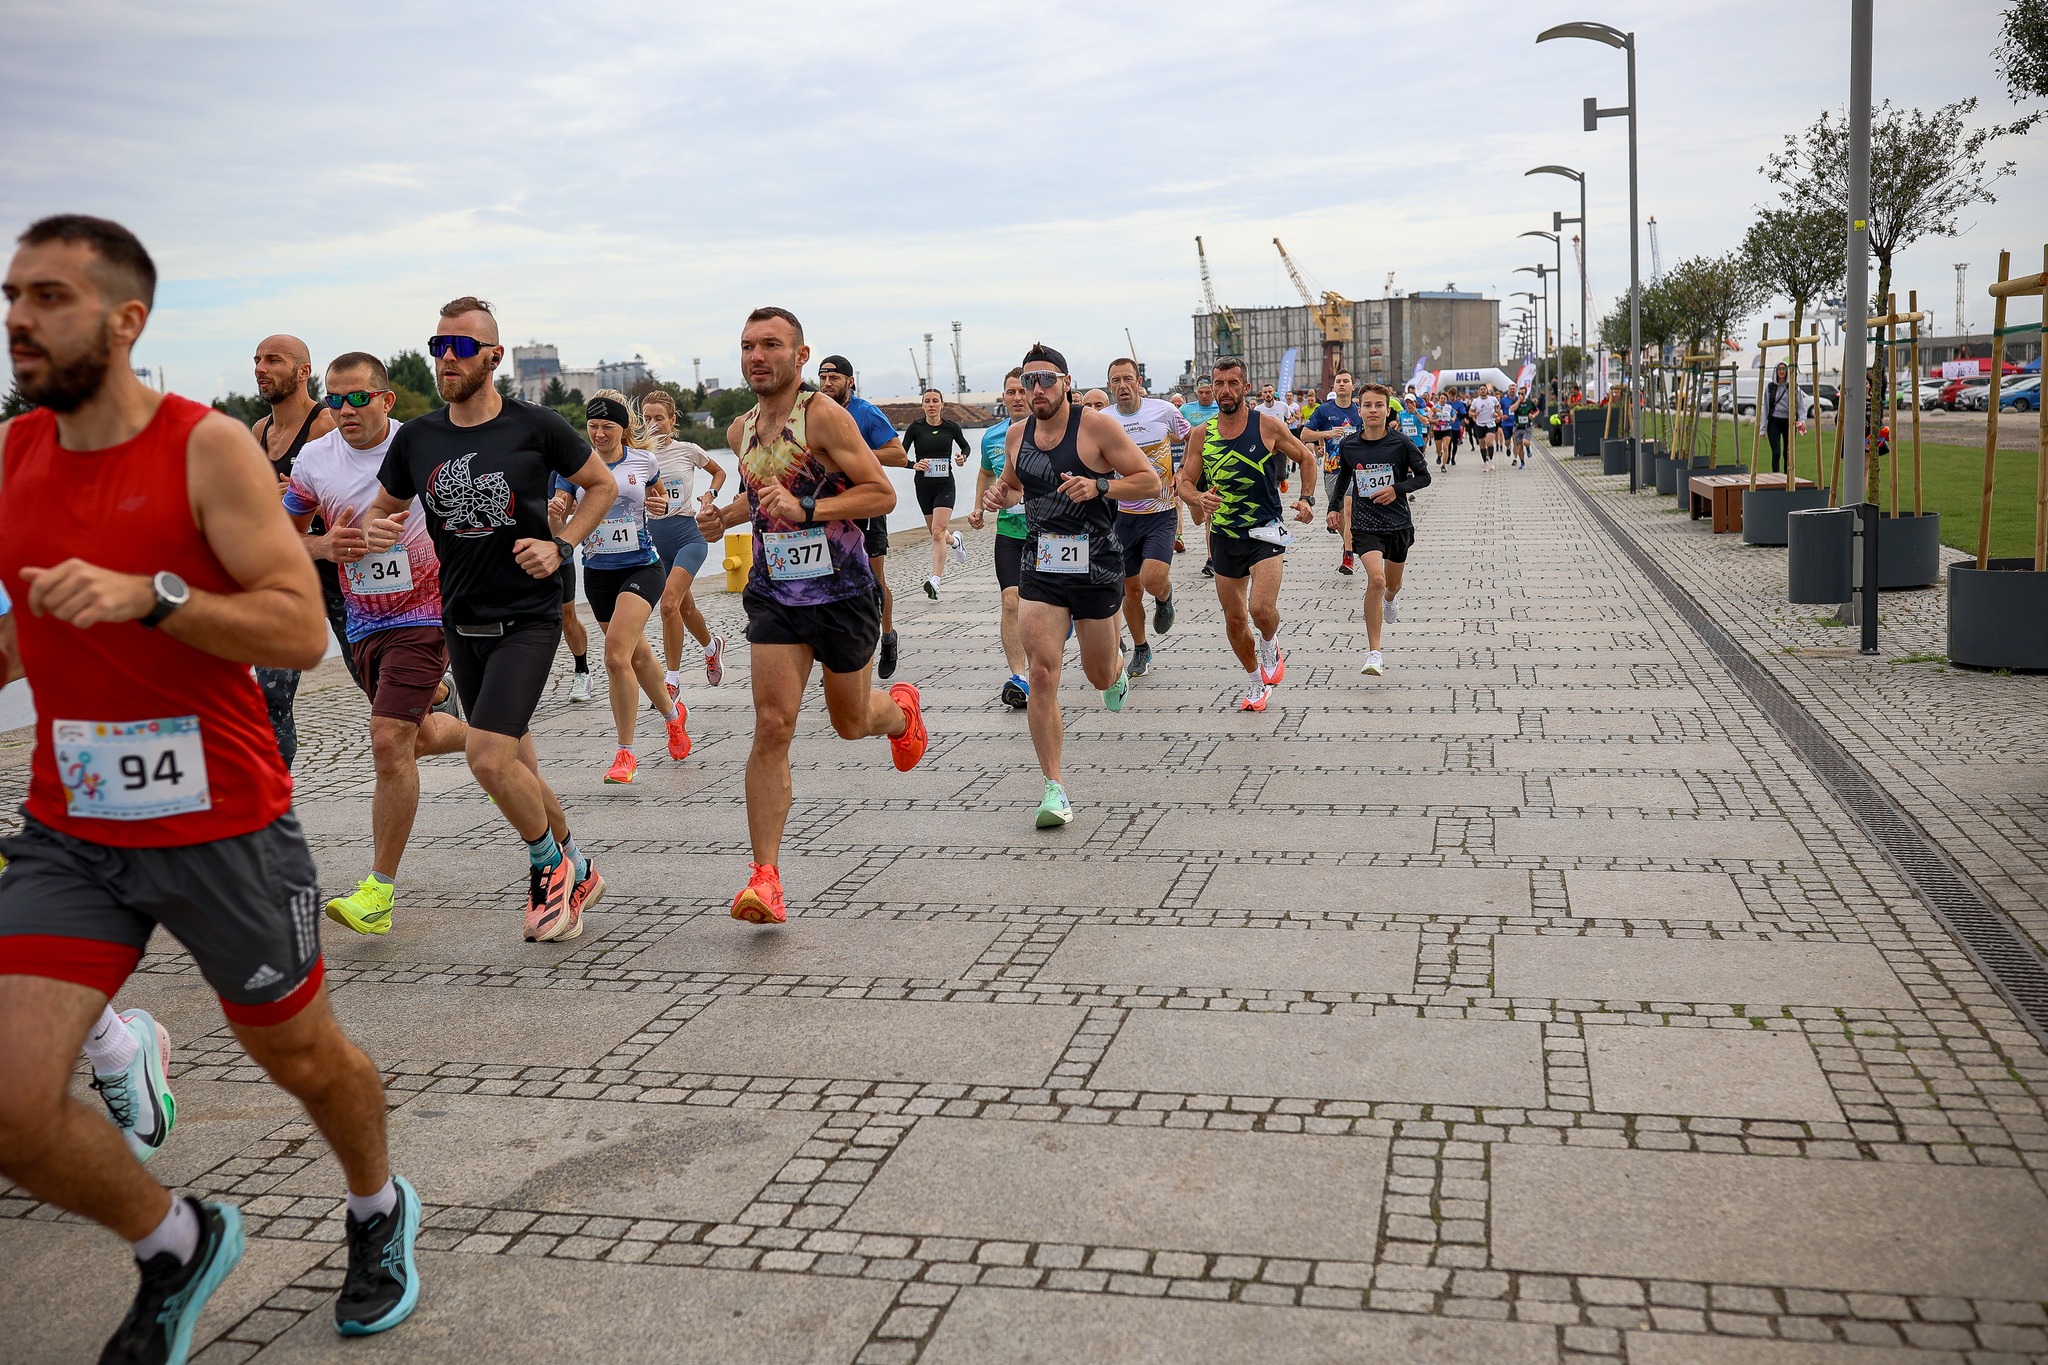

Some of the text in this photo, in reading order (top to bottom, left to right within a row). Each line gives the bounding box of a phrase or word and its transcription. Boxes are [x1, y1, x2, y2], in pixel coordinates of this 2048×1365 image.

[1456, 372, 1481, 381] META
[1369, 475, 1392, 488] 347
[612, 529, 628, 543] 41
[788, 543, 823, 566] 377
[1061, 546, 1078, 562] 21
[371, 560, 401, 580] 34
[118, 749, 185, 791] 94
